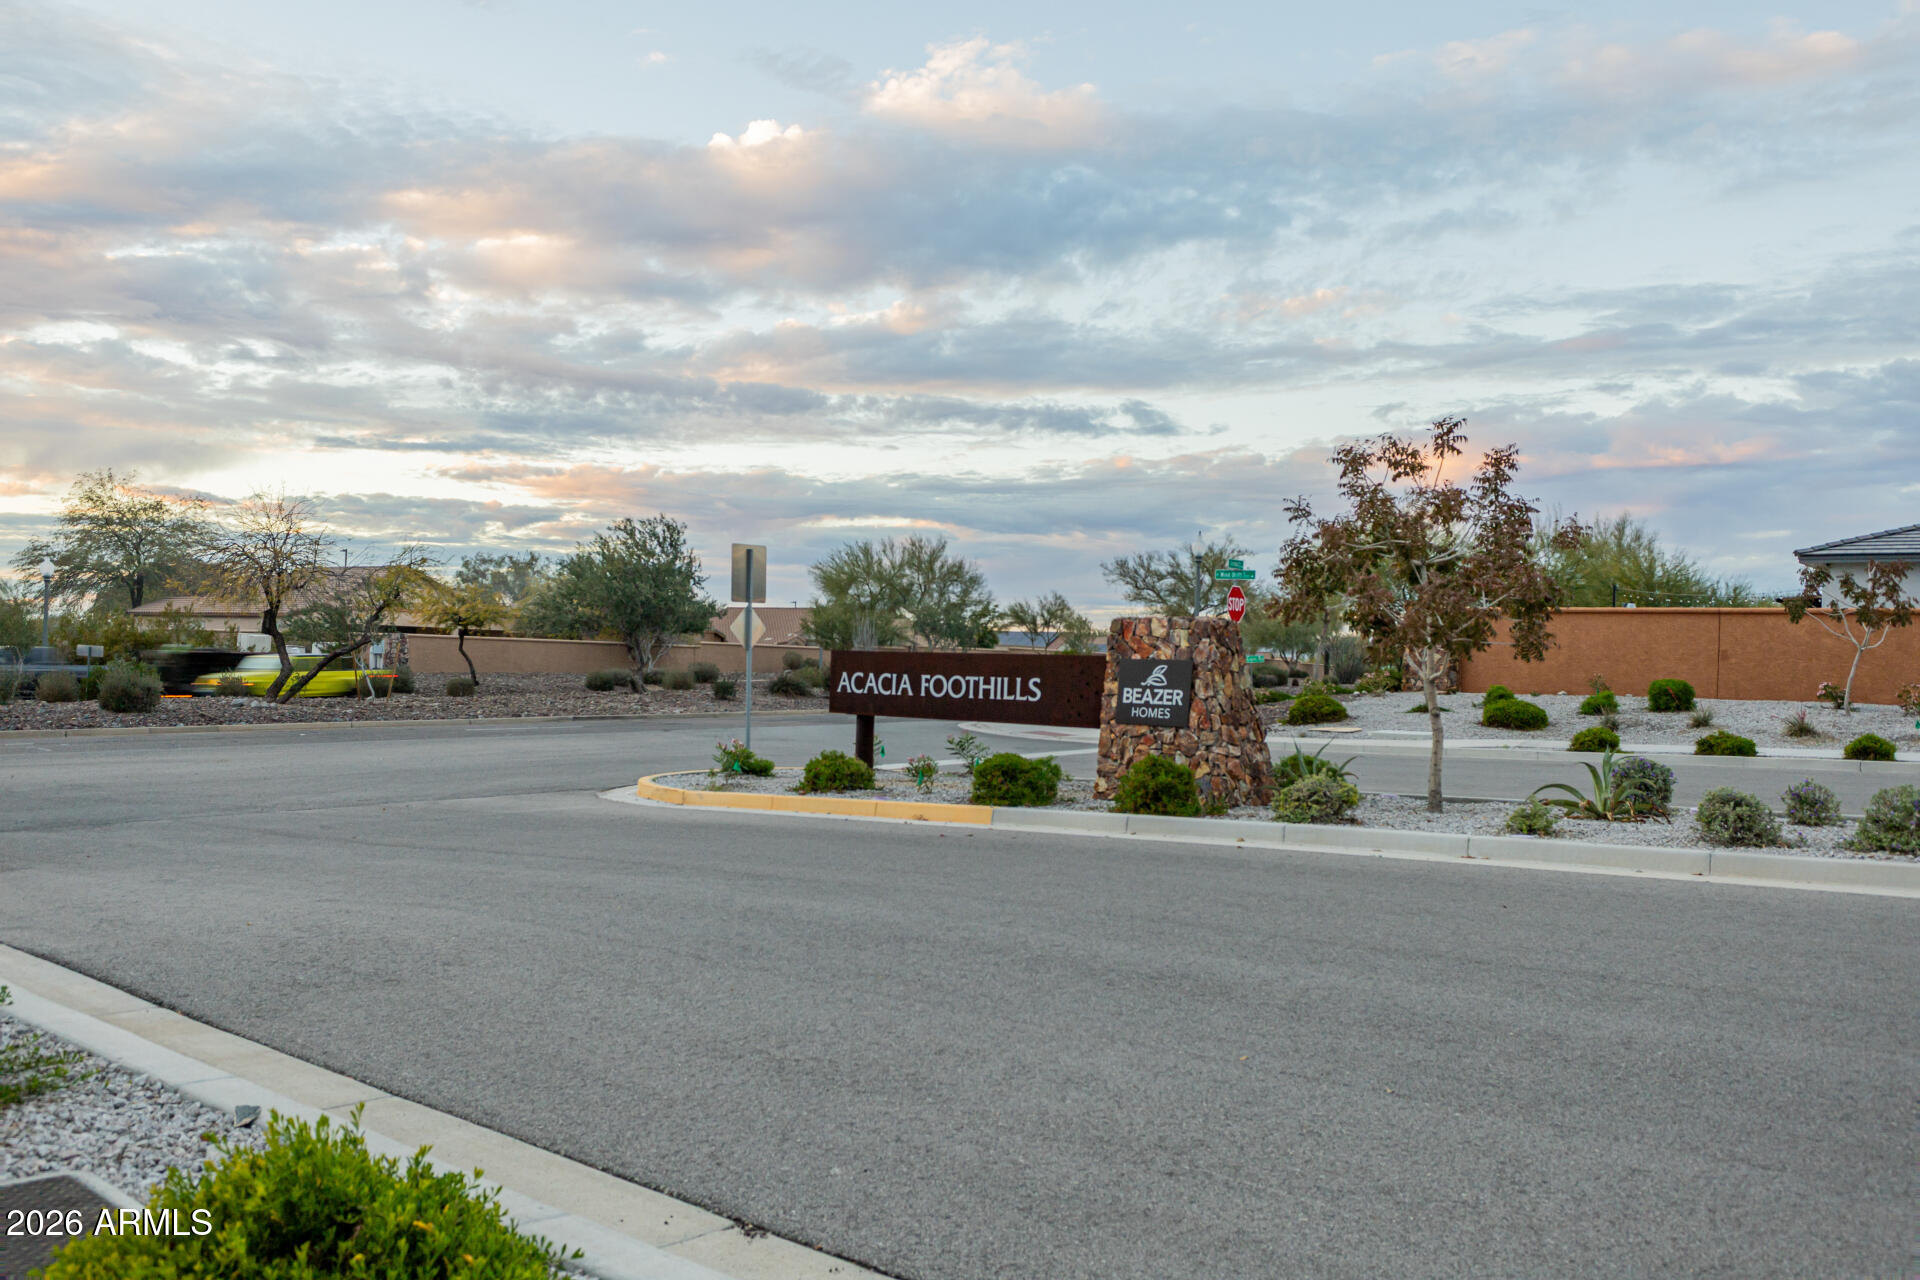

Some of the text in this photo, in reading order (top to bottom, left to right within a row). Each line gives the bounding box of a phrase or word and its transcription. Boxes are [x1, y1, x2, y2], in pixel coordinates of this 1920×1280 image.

[1228, 598, 1244, 612] STOP
[837, 671, 1042, 702] ACACIA FOOTHILLS
[1122, 687, 1184, 706] BEAZER
[1131, 707, 1171, 719] HOMES
